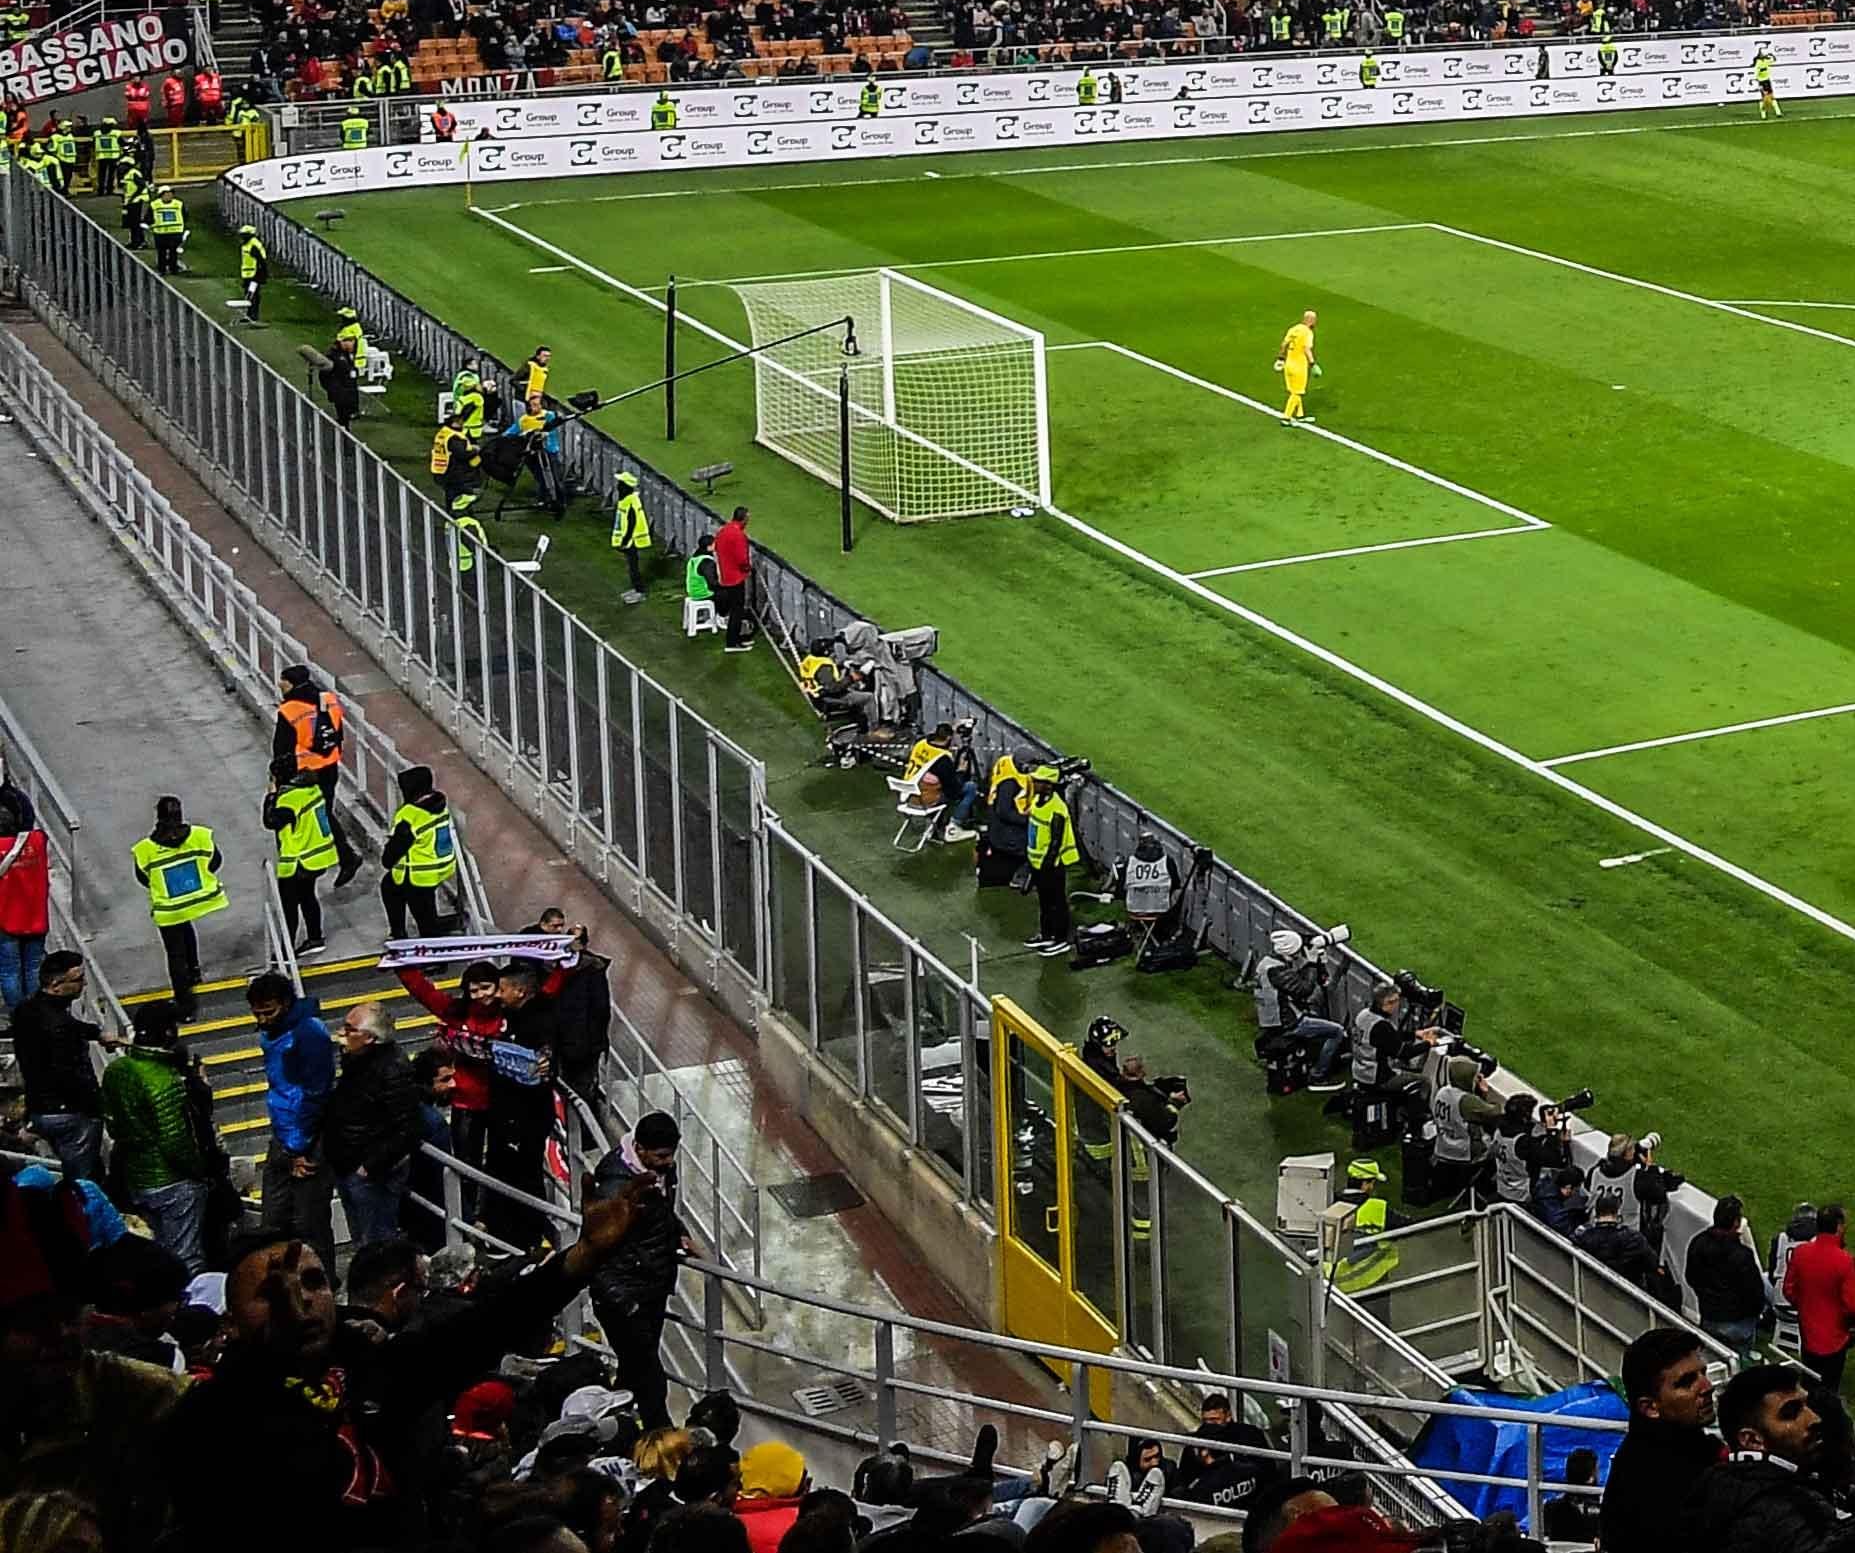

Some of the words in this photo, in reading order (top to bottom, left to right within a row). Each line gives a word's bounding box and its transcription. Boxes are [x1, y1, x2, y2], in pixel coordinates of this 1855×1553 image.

[0, 14, 164, 77] BASSANO
[0, 37, 188, 105] RESCIANO
[439, 70, 539, 100] MONZA
[1143, 79, 1170, 89] Group
[911, 92, 940, 102] Group
[983, 87, 1011, 97] Group
[685, 104, 716, 114] Group
[762, 99, 792, 109] Group
[526, 113, 557, 123] Group
[606, 108, 637, 118] Group
[1124, 114, 1153, 125] Group
[943, 126, 973, 136] Group
[1023, 121, 1052, 131] Group
[777, 136, 808, 147] Group
[861, 131, 892, 141] Group
[602, 146, 635, 157] Group
[691, 141, 723, 152] Group
[511, 151, 545, 162] Group
[418, 157, 452, 168] Group
[330, 164, 361, 176] Group
[1135, 864, 1160, 880] 096
